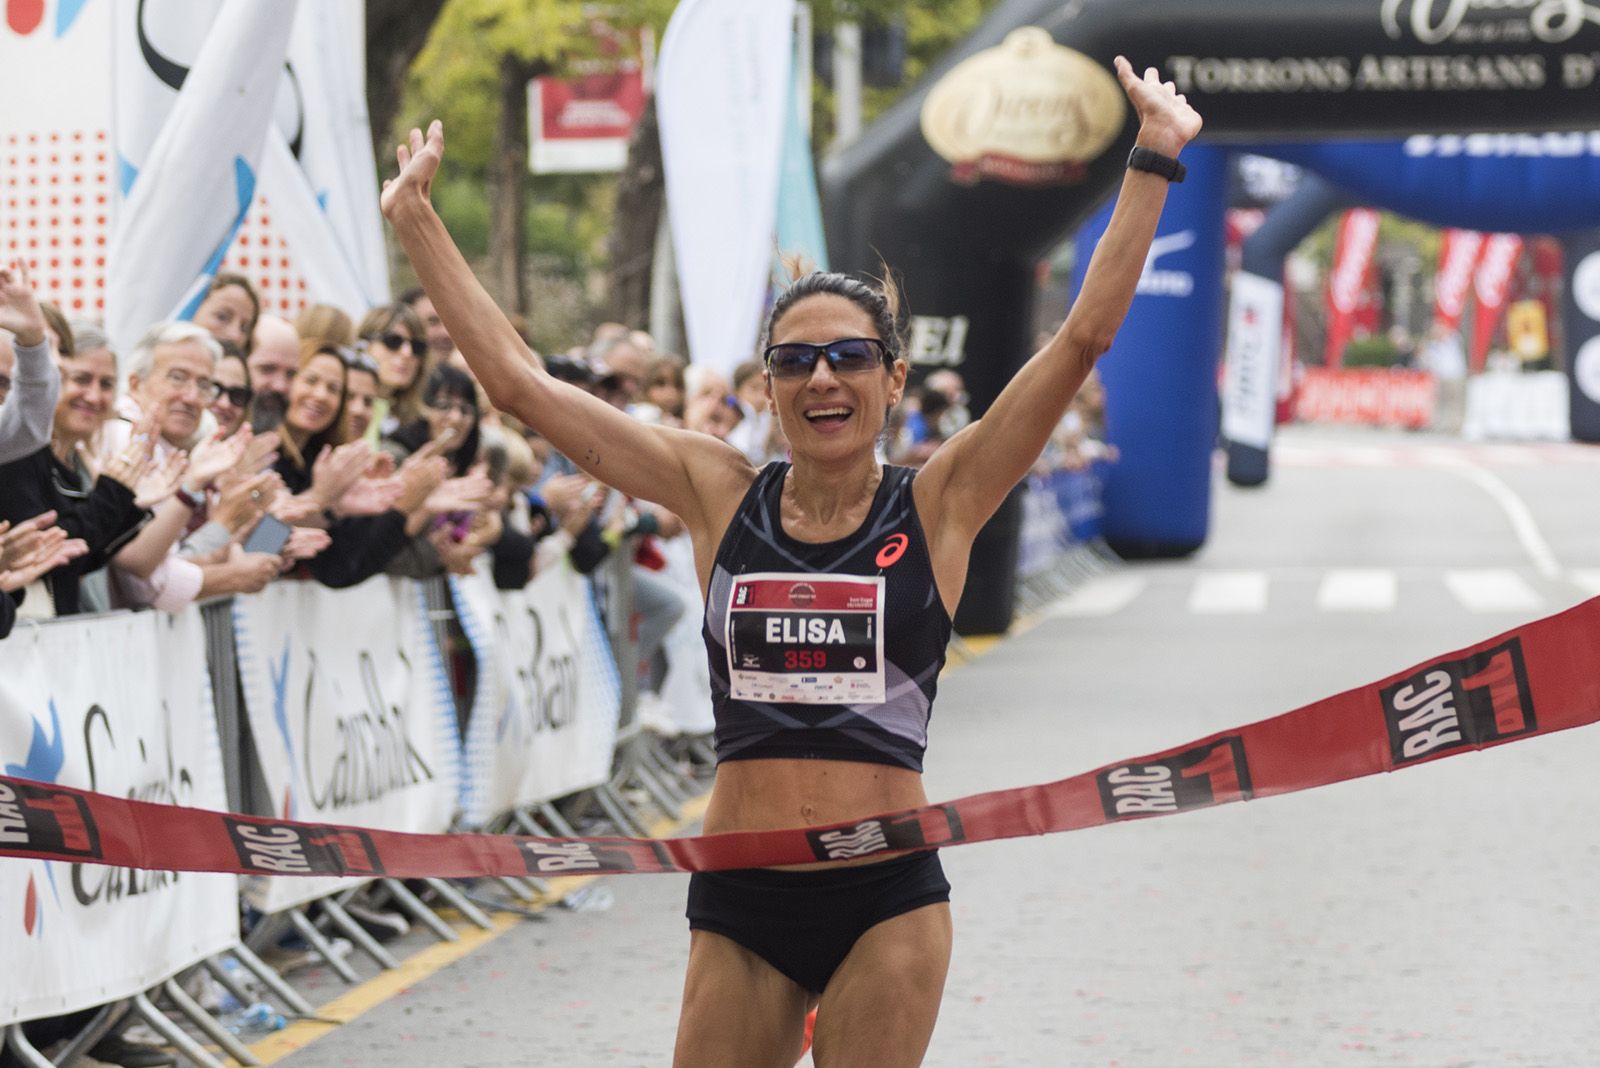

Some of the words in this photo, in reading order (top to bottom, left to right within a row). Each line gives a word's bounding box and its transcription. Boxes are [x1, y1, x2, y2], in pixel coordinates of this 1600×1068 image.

[1165, 55, 1350, 92] TORRONS
[1355, 54, 1546, 90] ARTESANS
[766, 617, 846, 644] ELISA
[784, 650, 827, 670] 359
